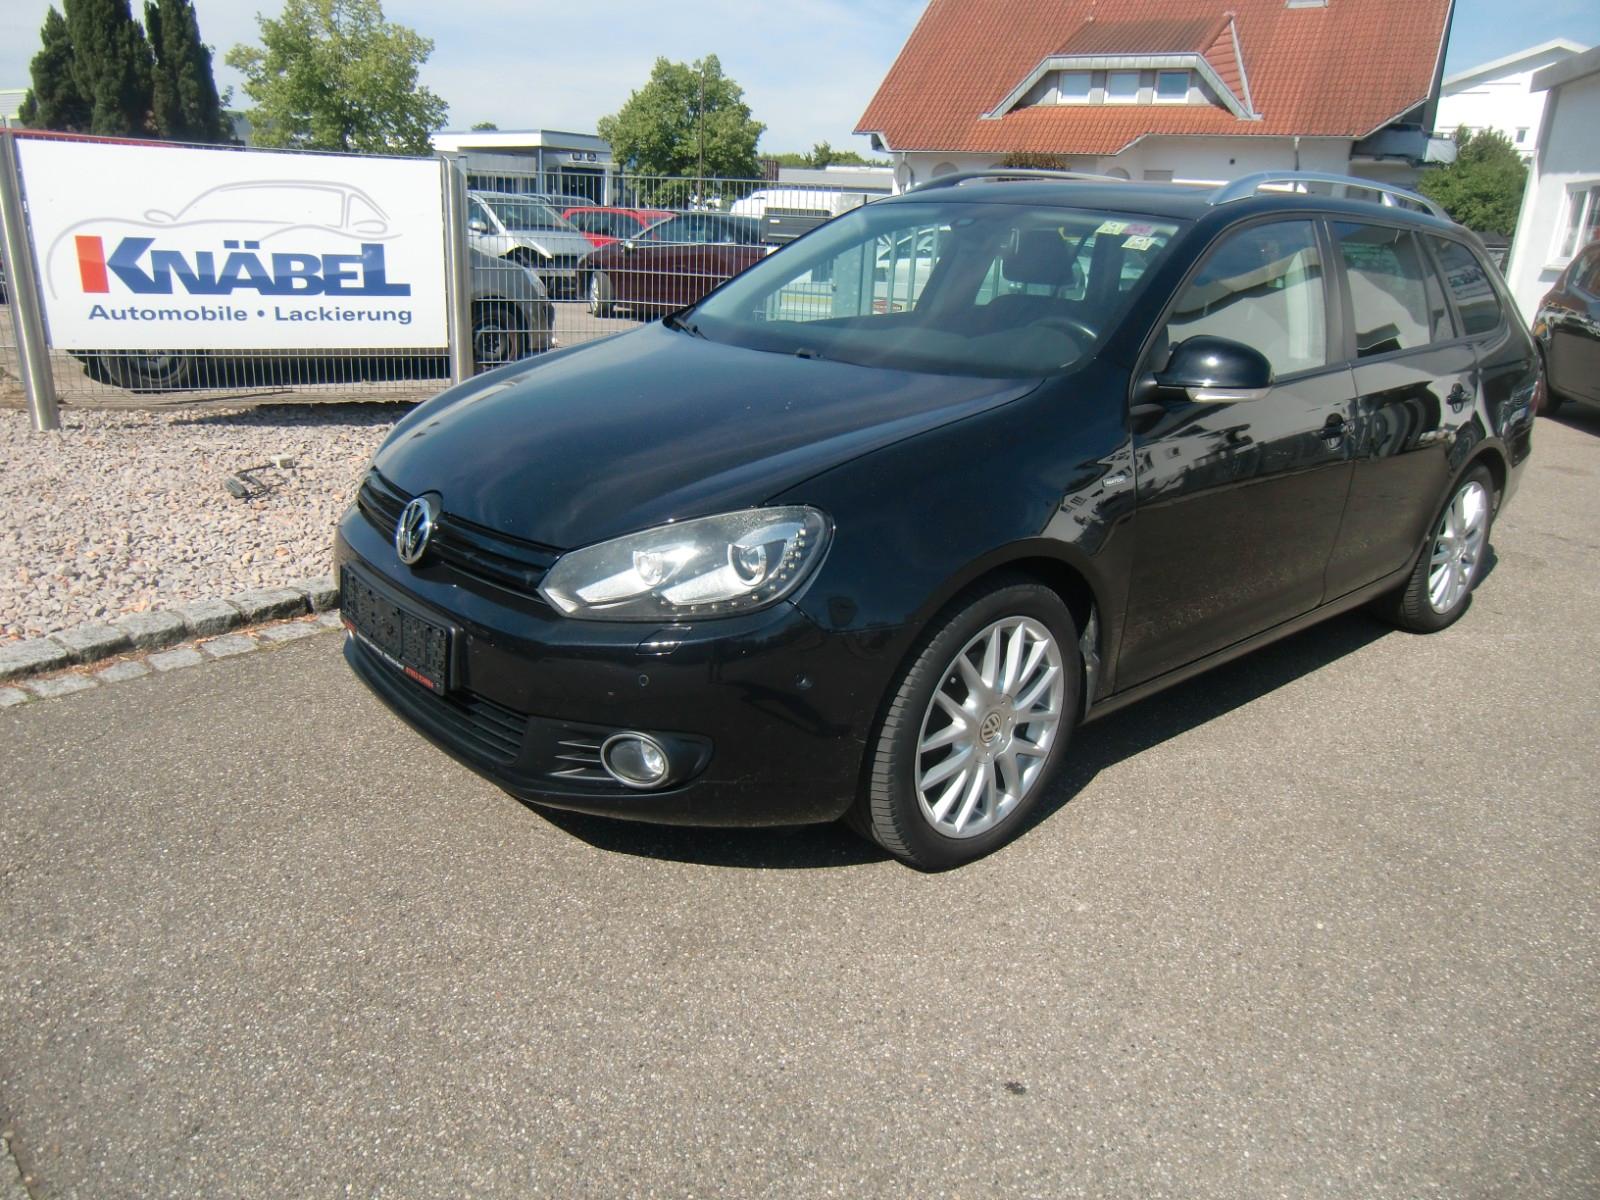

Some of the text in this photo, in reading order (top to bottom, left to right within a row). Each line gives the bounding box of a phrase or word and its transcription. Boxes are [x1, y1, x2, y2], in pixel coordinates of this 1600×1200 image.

[75, 235, 411, 297] KNÄBEL
[88, 304, 413, 325] Automobile Lackierung
